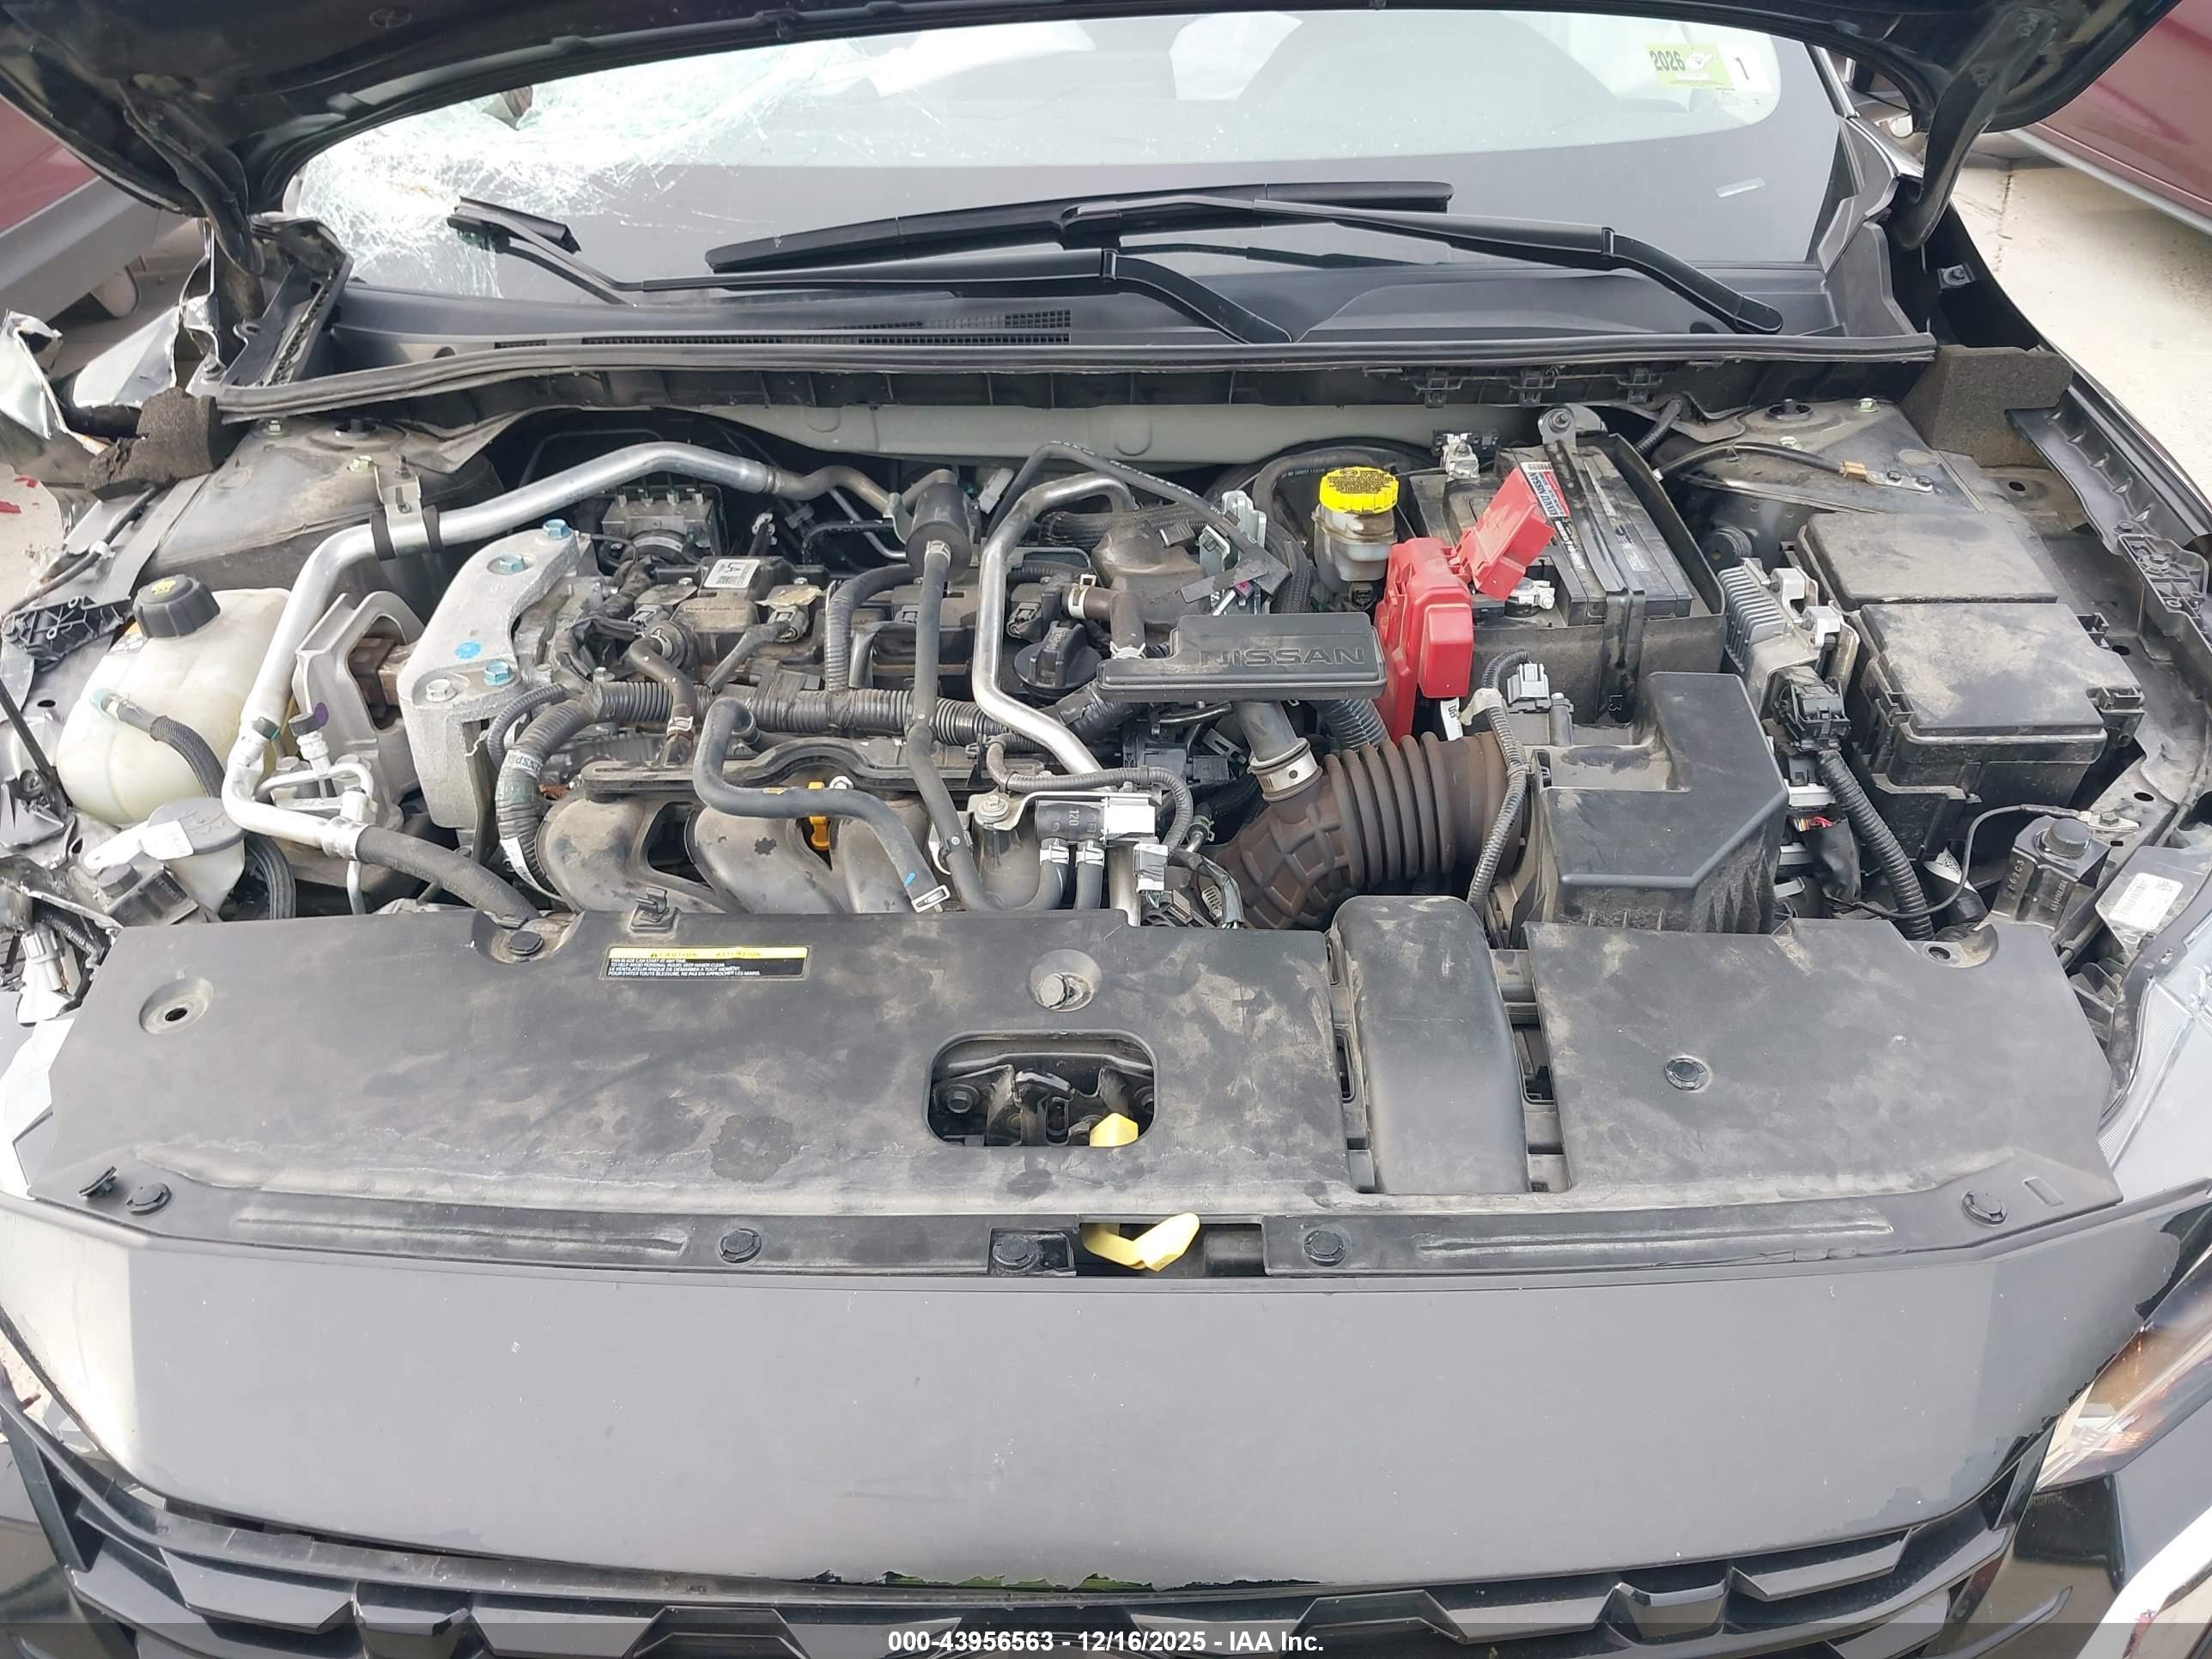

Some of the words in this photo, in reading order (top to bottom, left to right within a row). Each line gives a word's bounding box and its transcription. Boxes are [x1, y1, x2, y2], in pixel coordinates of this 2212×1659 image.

[1650, 50, 1686, 71] 2026
[1735, 58, 1750, 81] 1
[1199, 647, 1365, 667] NISSAN
